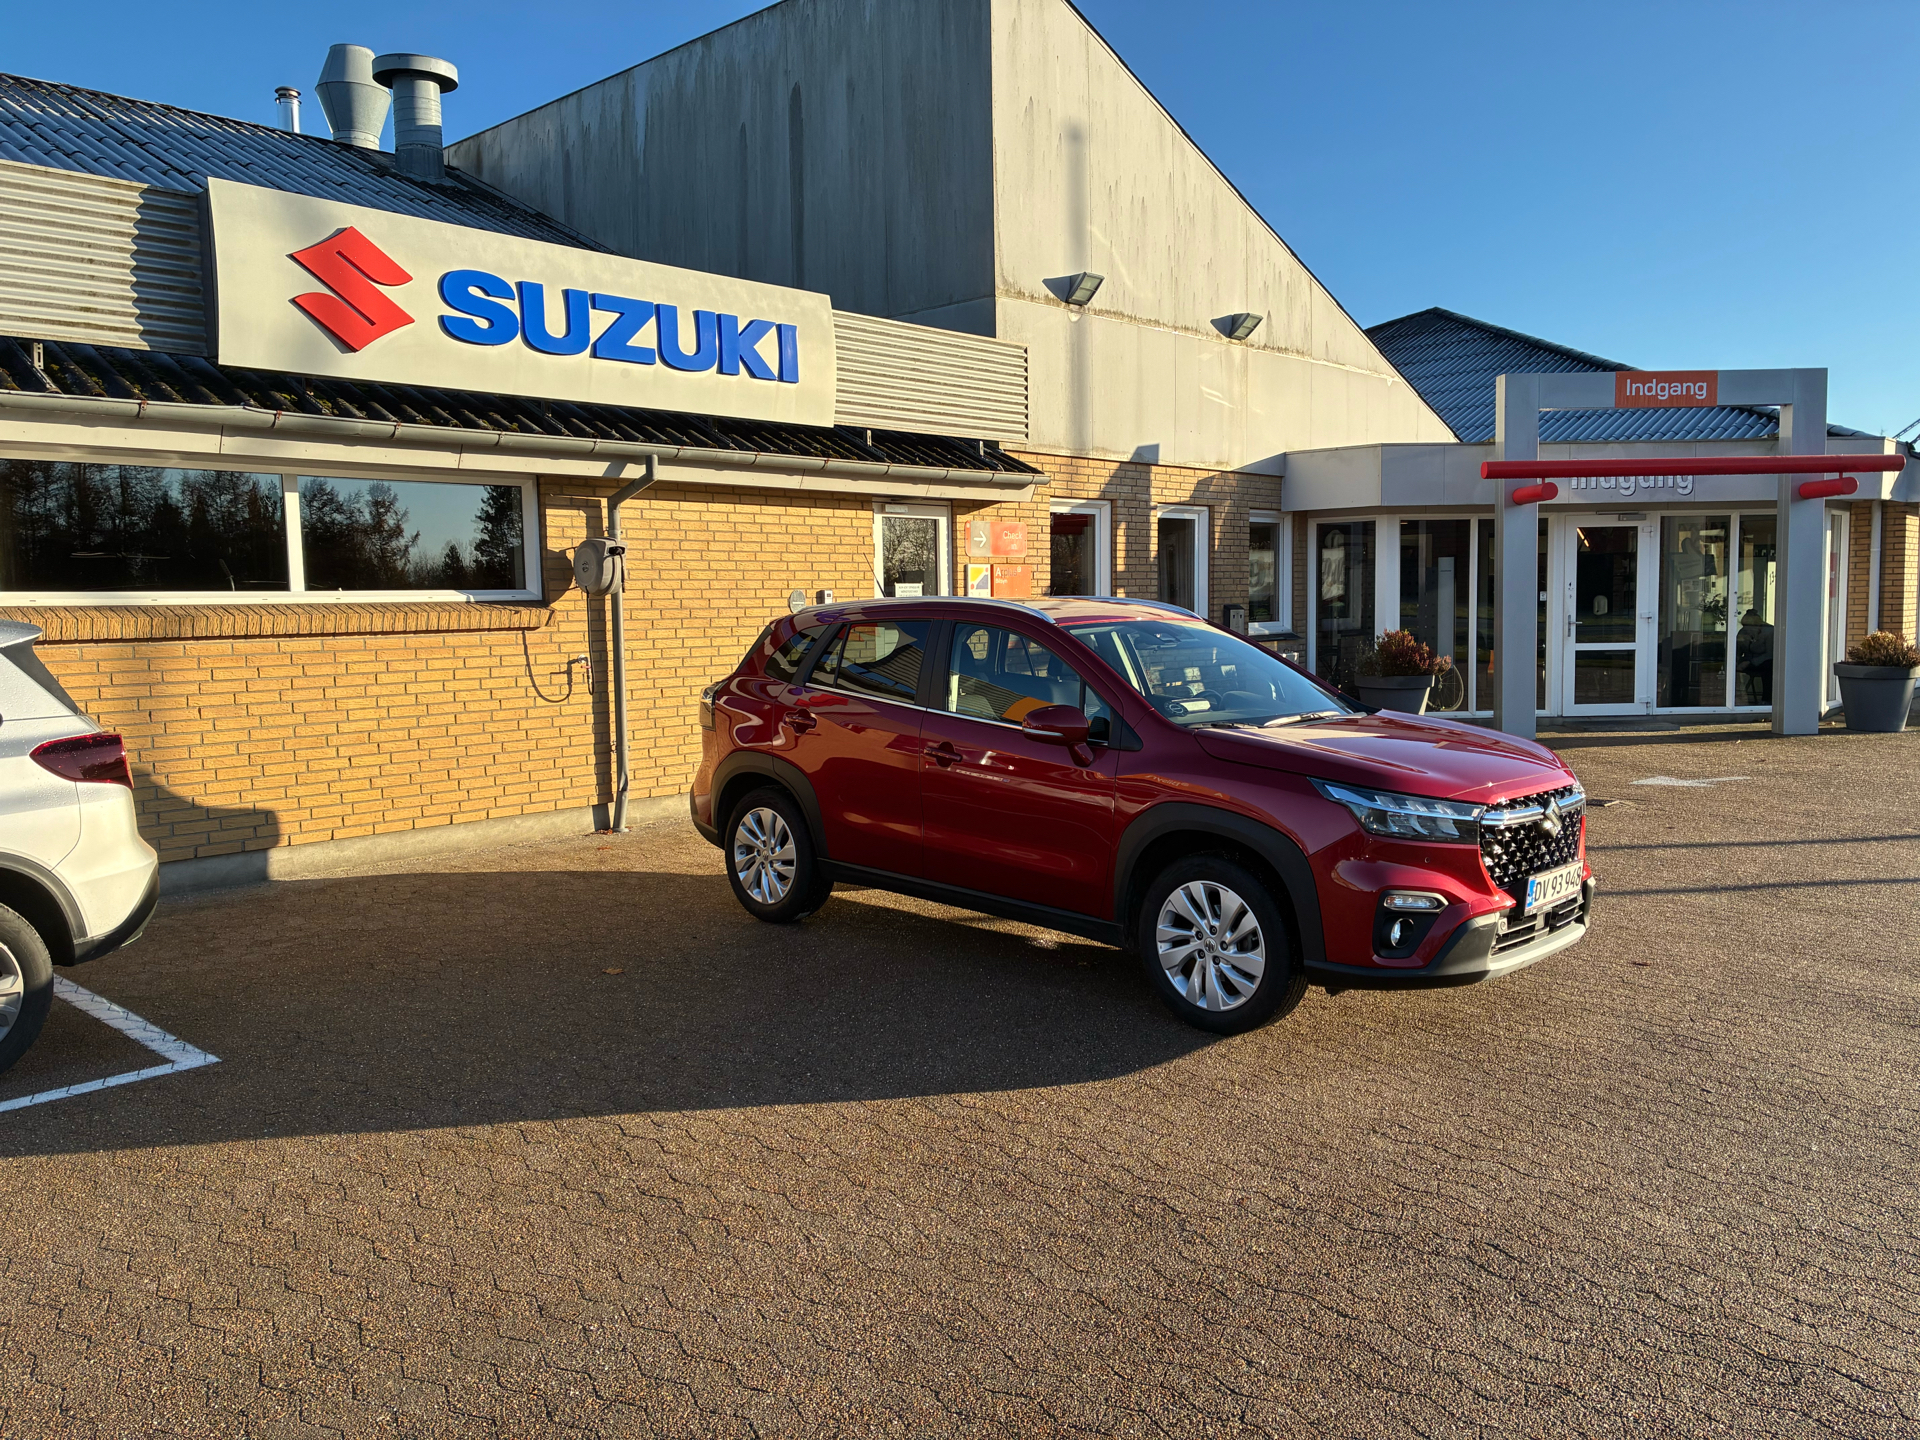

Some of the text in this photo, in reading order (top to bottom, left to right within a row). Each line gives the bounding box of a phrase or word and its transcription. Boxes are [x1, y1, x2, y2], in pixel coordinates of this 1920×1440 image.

[438, 269, 799, 384] SUZUKI
[1626, 379, 1707, 399] Indgang
[1003, 530, 1022, 540] Check
[1534, 866, 1581, 902] DV 93 948
